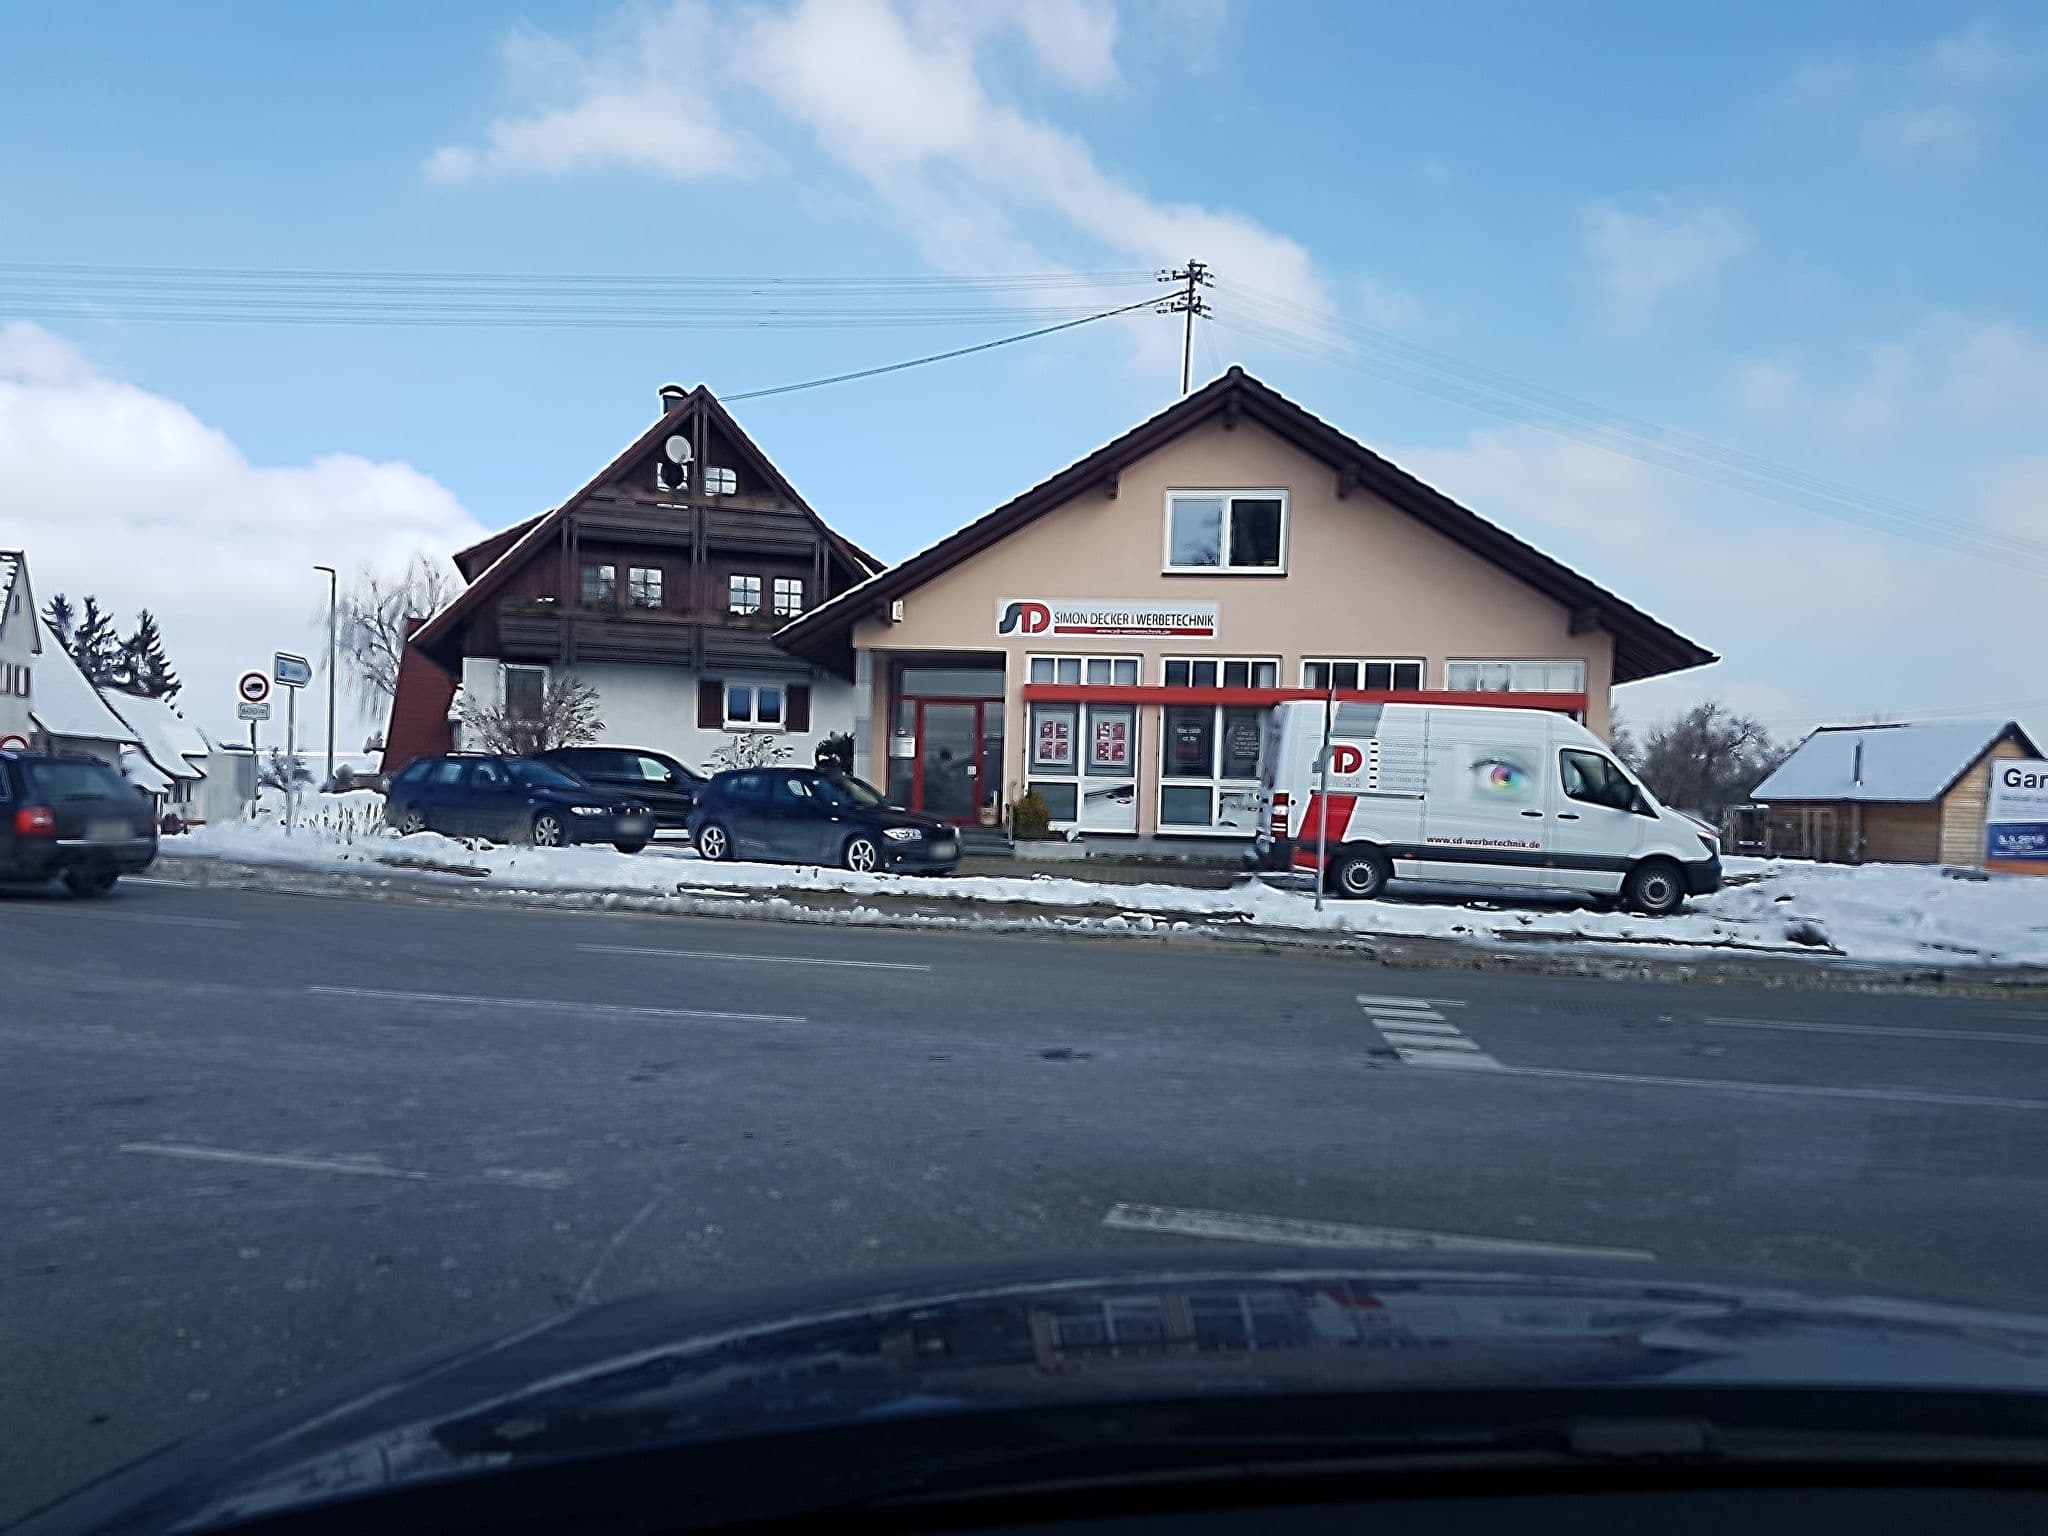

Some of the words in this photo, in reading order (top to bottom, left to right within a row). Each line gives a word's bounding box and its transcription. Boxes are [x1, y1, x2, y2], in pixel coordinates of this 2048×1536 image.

[1054, 612, 1088, 625] SIMON
[1090, 612, 1129, 625] DECKER
[1136, 613, 1214, 627] WERBETECHNIK
[1426, 837, 1541, 849] www.sd-werbetechnik.de
